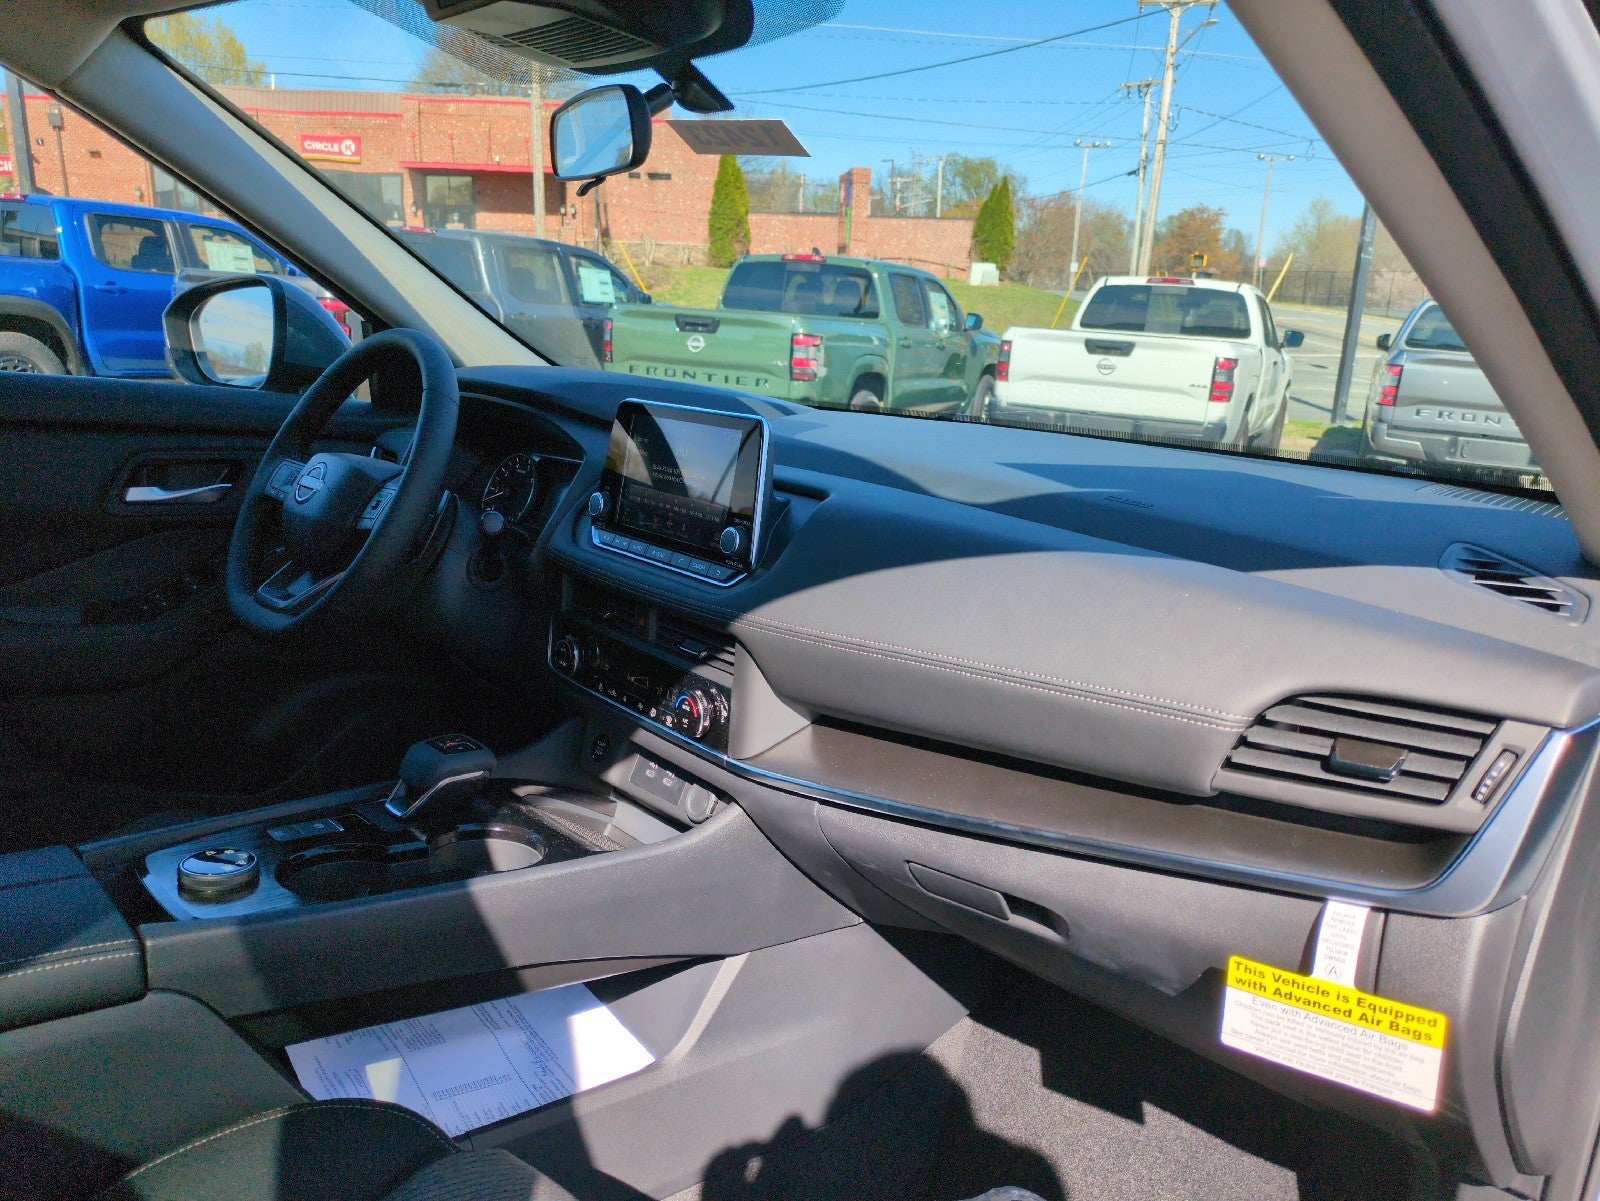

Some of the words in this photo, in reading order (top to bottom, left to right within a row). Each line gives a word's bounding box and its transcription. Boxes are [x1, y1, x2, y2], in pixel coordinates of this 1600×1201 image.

[303, 140, 340, 152] CIRCLE
[628, 364, 769, 388] FRONTIER
[1413, 407, 1512, 425] FRON
[1234, 960, 1265, 979] This
[1271, 971, 1330, 998] Vehicle
[1336, 990, 1350, 1003] is
[1356, 996, 1437, 1029] Equipped
[1234, 975, 1267, 993] with
[1272, 985, 1352, 1018] Advanced
[1358, 1011, 1382, 1027] Air
[1388, 1020, 1432, 1043] Bags
[1251, 996, 1277, 1011] Even
[1280, 1005, 1301, 1019] with
[1303, 1012, 1356, 1035] Advanced
[1360, 1028, 1374, 1041] Air
[1378, 1034, 1408, 1053] Bags
